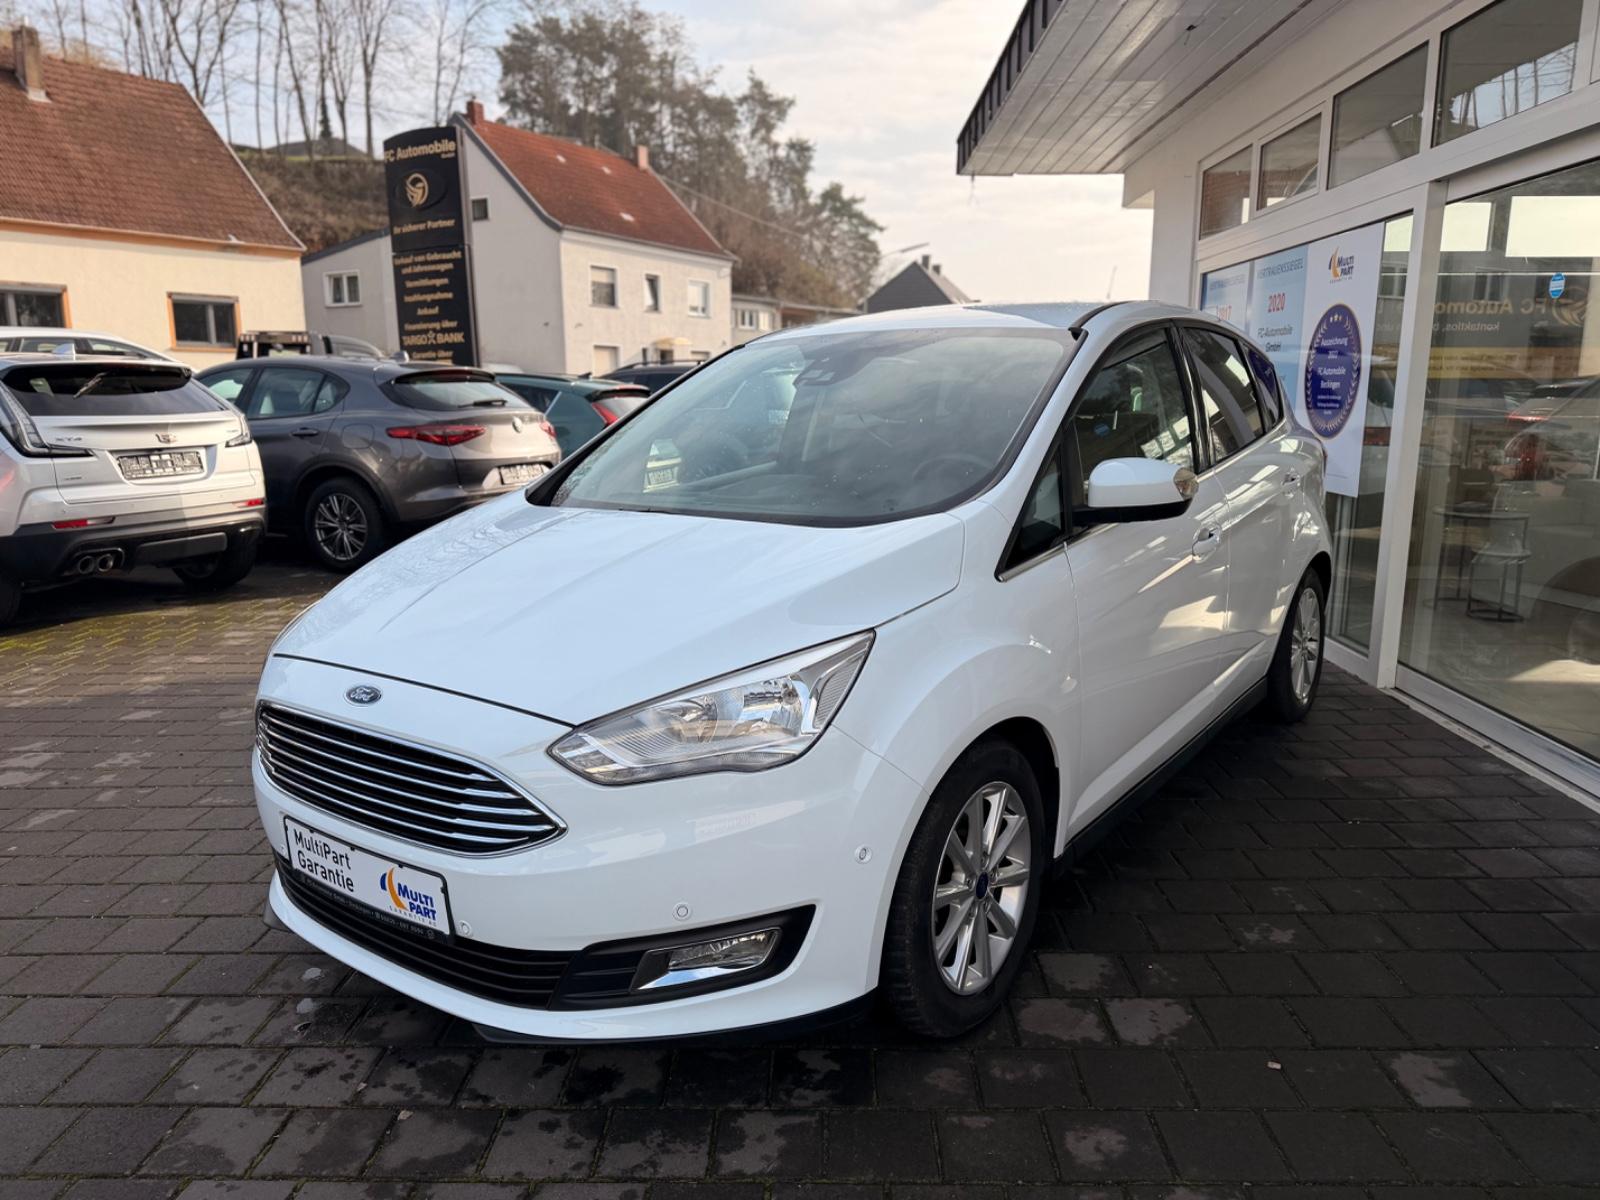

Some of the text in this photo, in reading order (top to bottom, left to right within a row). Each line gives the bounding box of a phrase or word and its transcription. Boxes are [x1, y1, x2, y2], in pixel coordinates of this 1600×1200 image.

[384, 138, 456, 163] FC Automobile
[1340, 265, 1354, 277] PART
[1267, 292, 1286, 313] 2020
[436, 331, 465, 344] BANK
[293, 828, 352, 870] MultiPart
[297, 850, 355, 892] Garantie
[408, 901, 437, 921] PART
